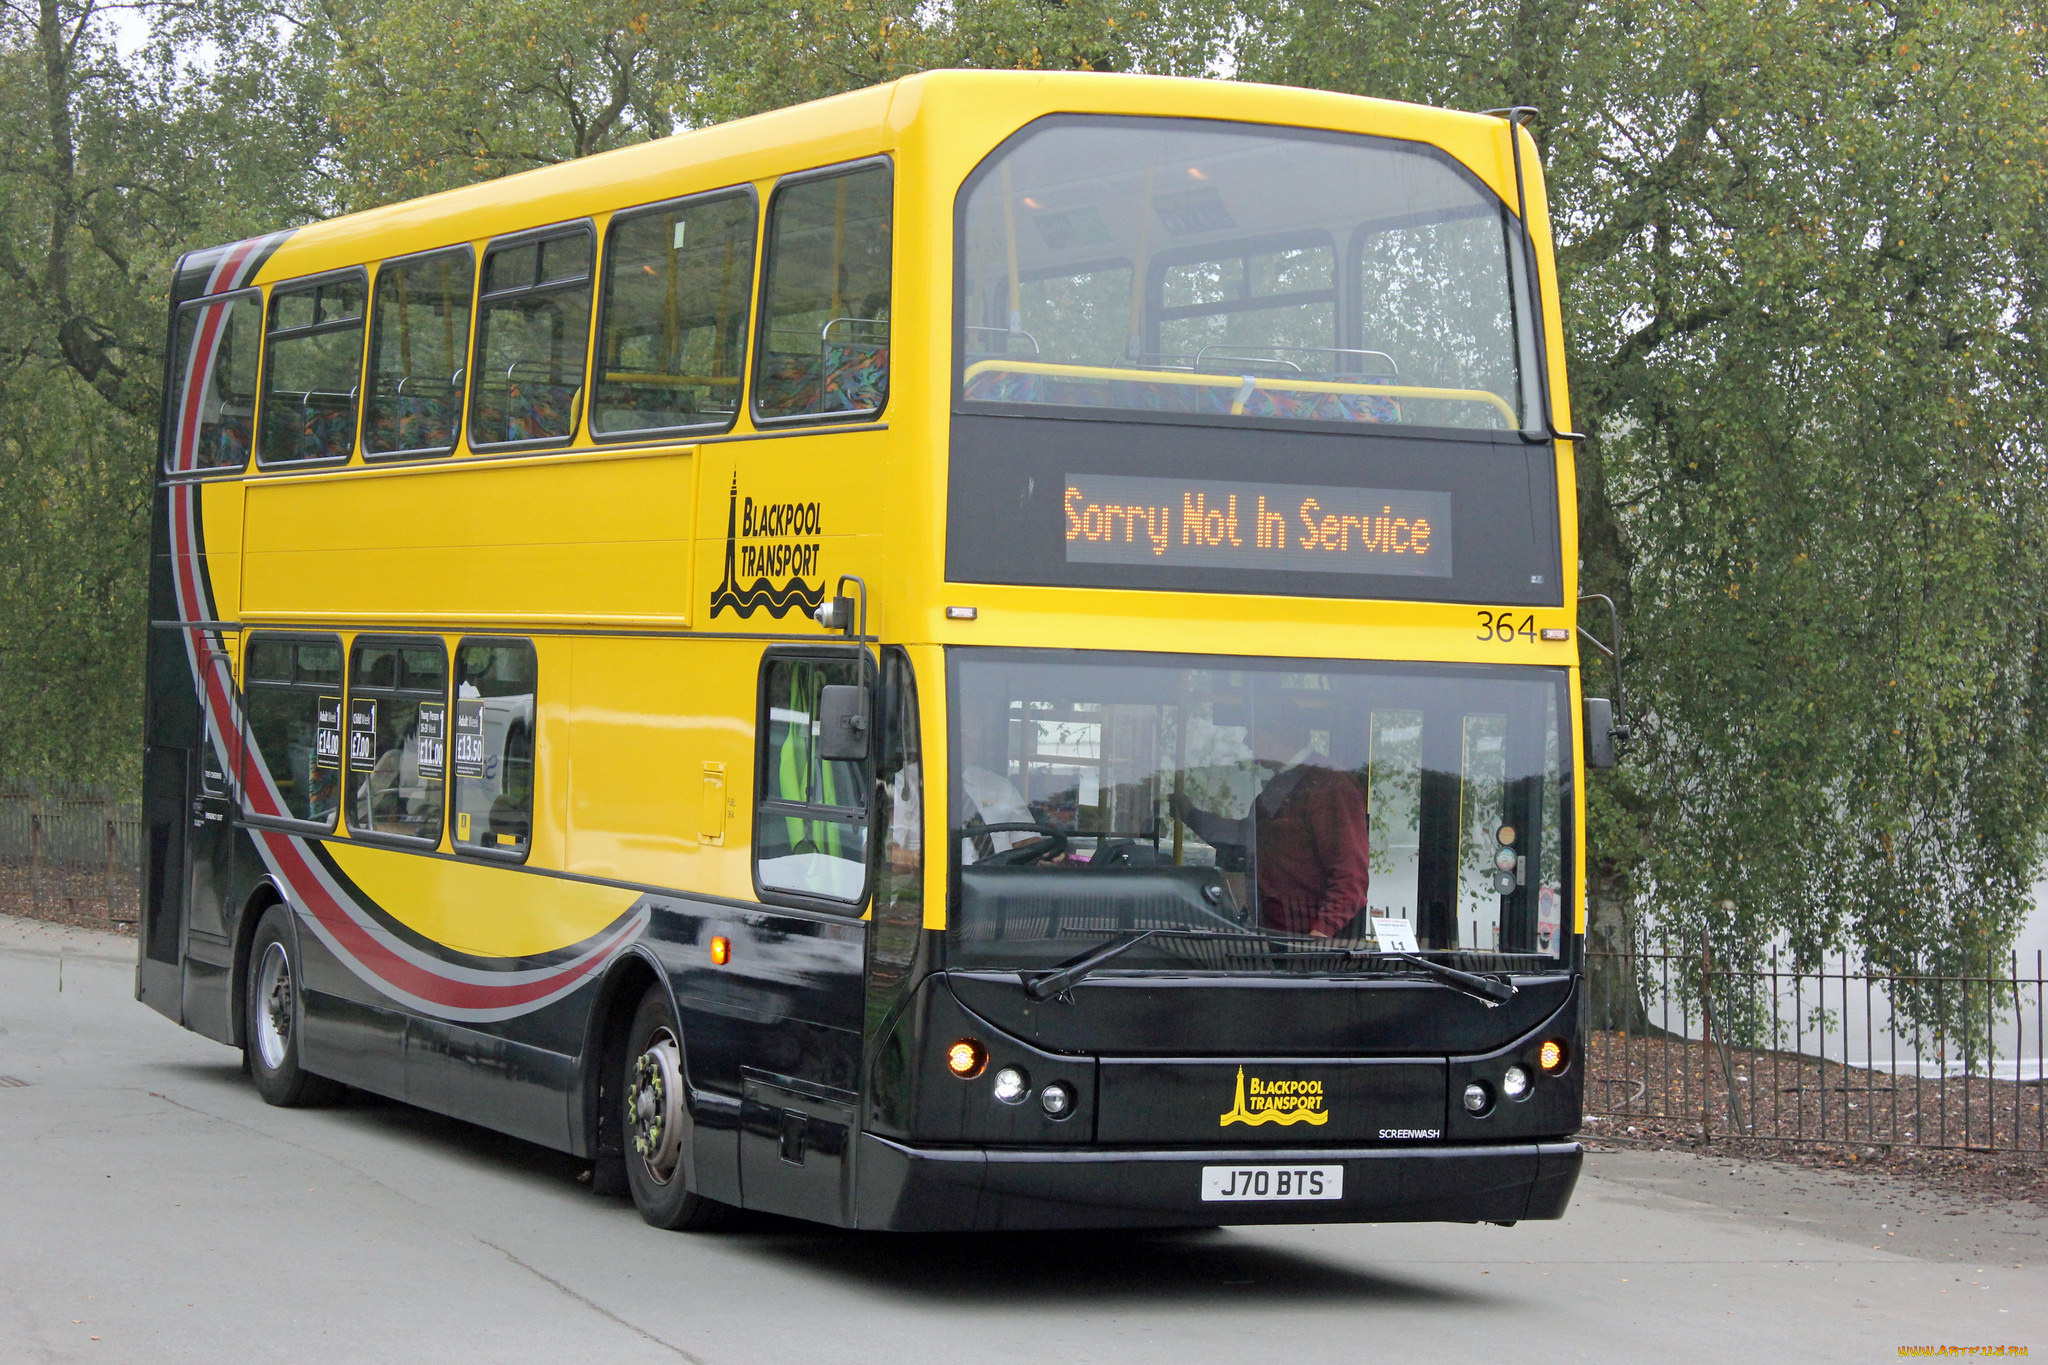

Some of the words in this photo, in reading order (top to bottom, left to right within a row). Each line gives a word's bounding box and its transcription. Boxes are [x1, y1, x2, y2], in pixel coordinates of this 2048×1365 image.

[742, 497, 821, 537] BLACKPOOL
[1065, 487, 1168, 555] Sorry
[1182, 492, 1242, 546] Not
[1257, 495, 1286, 548] In
[1300, 498, 1431, 554] Service
[741, 543, 820, 577] TRANSPORT
[1476, 610, 1537, 644] 364
[319, 730, 339, 755] £14.00
[352, 732, 370, 758] £7.00
[420, 738, 444, 765] £11.00
[457, 735, 482, 762] £13.50
[1391, 940, 1406, 951] L1
[1250, 1077, 1324, 1095] BLACKPOOL
[1250, 1095, 1323, 1110] TRANSPORT
[1378, 1129, 1440, 1139] SCREENWASH
[1221, 1170, 1269, 1196] J70
[1276, 1170, 1324, 1196] BTS
